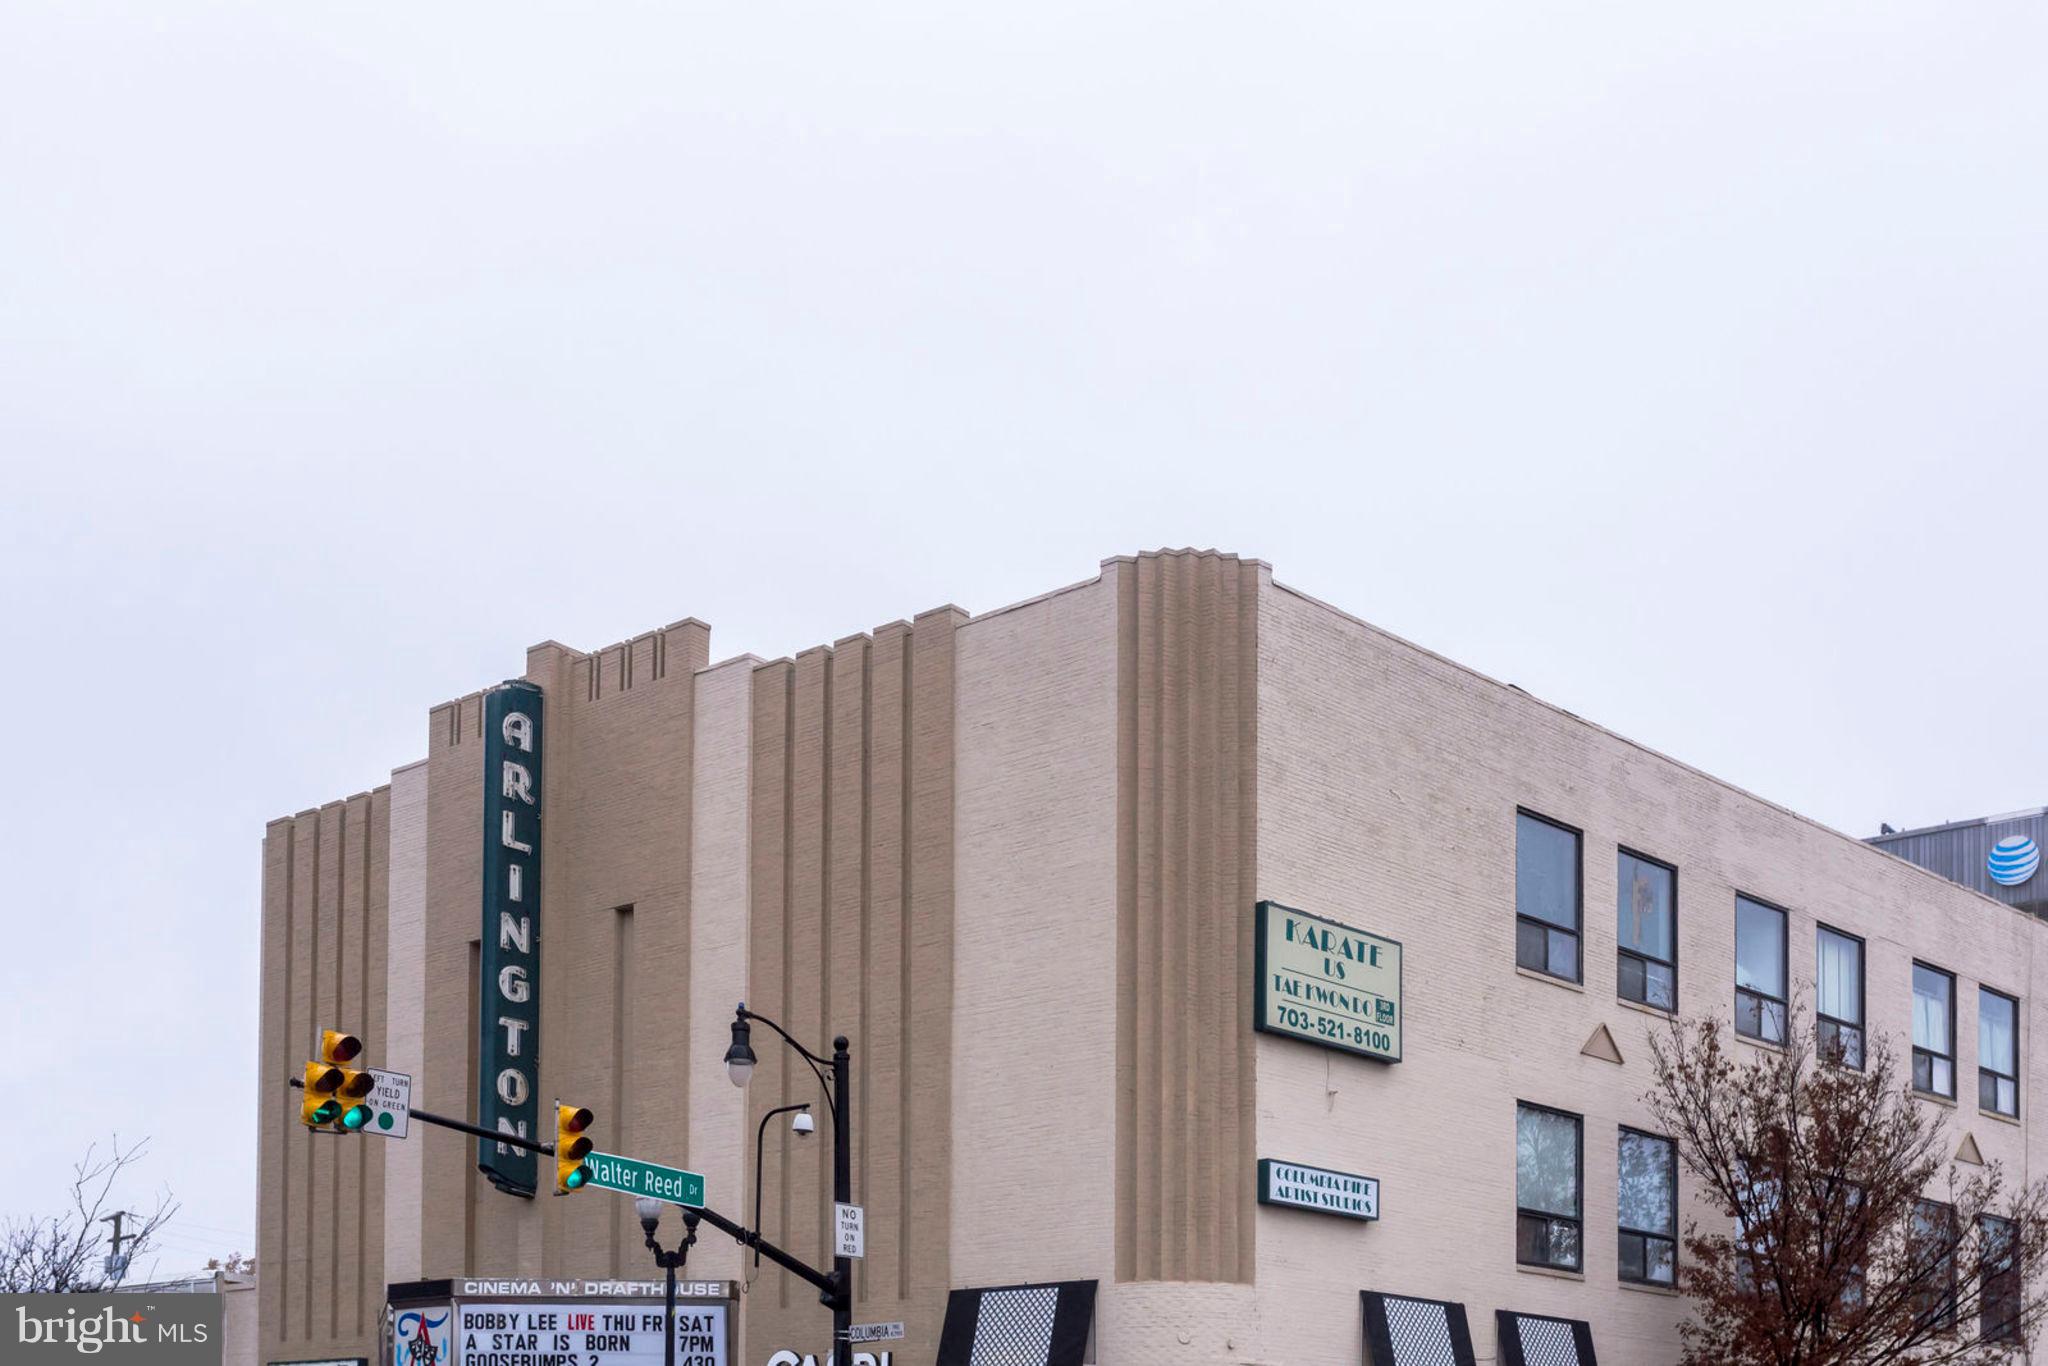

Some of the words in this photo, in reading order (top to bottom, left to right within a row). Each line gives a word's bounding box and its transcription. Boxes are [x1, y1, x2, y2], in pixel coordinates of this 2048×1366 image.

[497, 711, 535, 1158] ARLINGTON
[1286, 918, 1383, 969] KARATE
[1324, 958, 1345, 980] US
[1273, 973, 1301, 999] TAE
[1305, 983, 1349, 1011] KWON
[1352, 996, 1373, 1017] DO
[1277, 1005, 1390, 1051] 703-521-8100
[373, 1074, 384, 1083] EFT
[392, 1078, 408, 1087] TURN
[377, 1086, 400, 1099] YIELD
[369, 1098, 378, 1106] ON
[382, 1101, 406, 1111] GREEN
[585, 1157, 638, 1188] Walter
[644, 1170, 682, 1198] Reed
[689, 1184, 698, 1195] Dr
[1276, 1167, 1341, 1190] COLUMBIA
[1275, 1186, 1318, 1204] ARTIST
[1321, 1193, 1372, 1213] STUDIOS
[842, 1209, 857, 1220] NO
[841, 1221, 859, 1231] TURN
[844, 1233, 855, 1242] ON
[843, 1244, 857, 1254] RED
[464, 1281, 542, 1294] CINEMA
[464, 1313, 520, 1330] BOBBY
[528, 1314, 557, 1330] LEE
[568, 1314, 595, 1331] LIVE
[603, 1315, 635, 1331] THU
[680, 1316, 714, 1332] SAT
[851, 1325, 889, 1339] COLUMBIA
[466, 1334, 477, 1350] A
[493, 1334, 538, 1350] STAR
[554, 1335, 570, 1350] IS
[586, 1335, 630, 1351] BORN
[680, 1336, 714, 1352] 7PM
